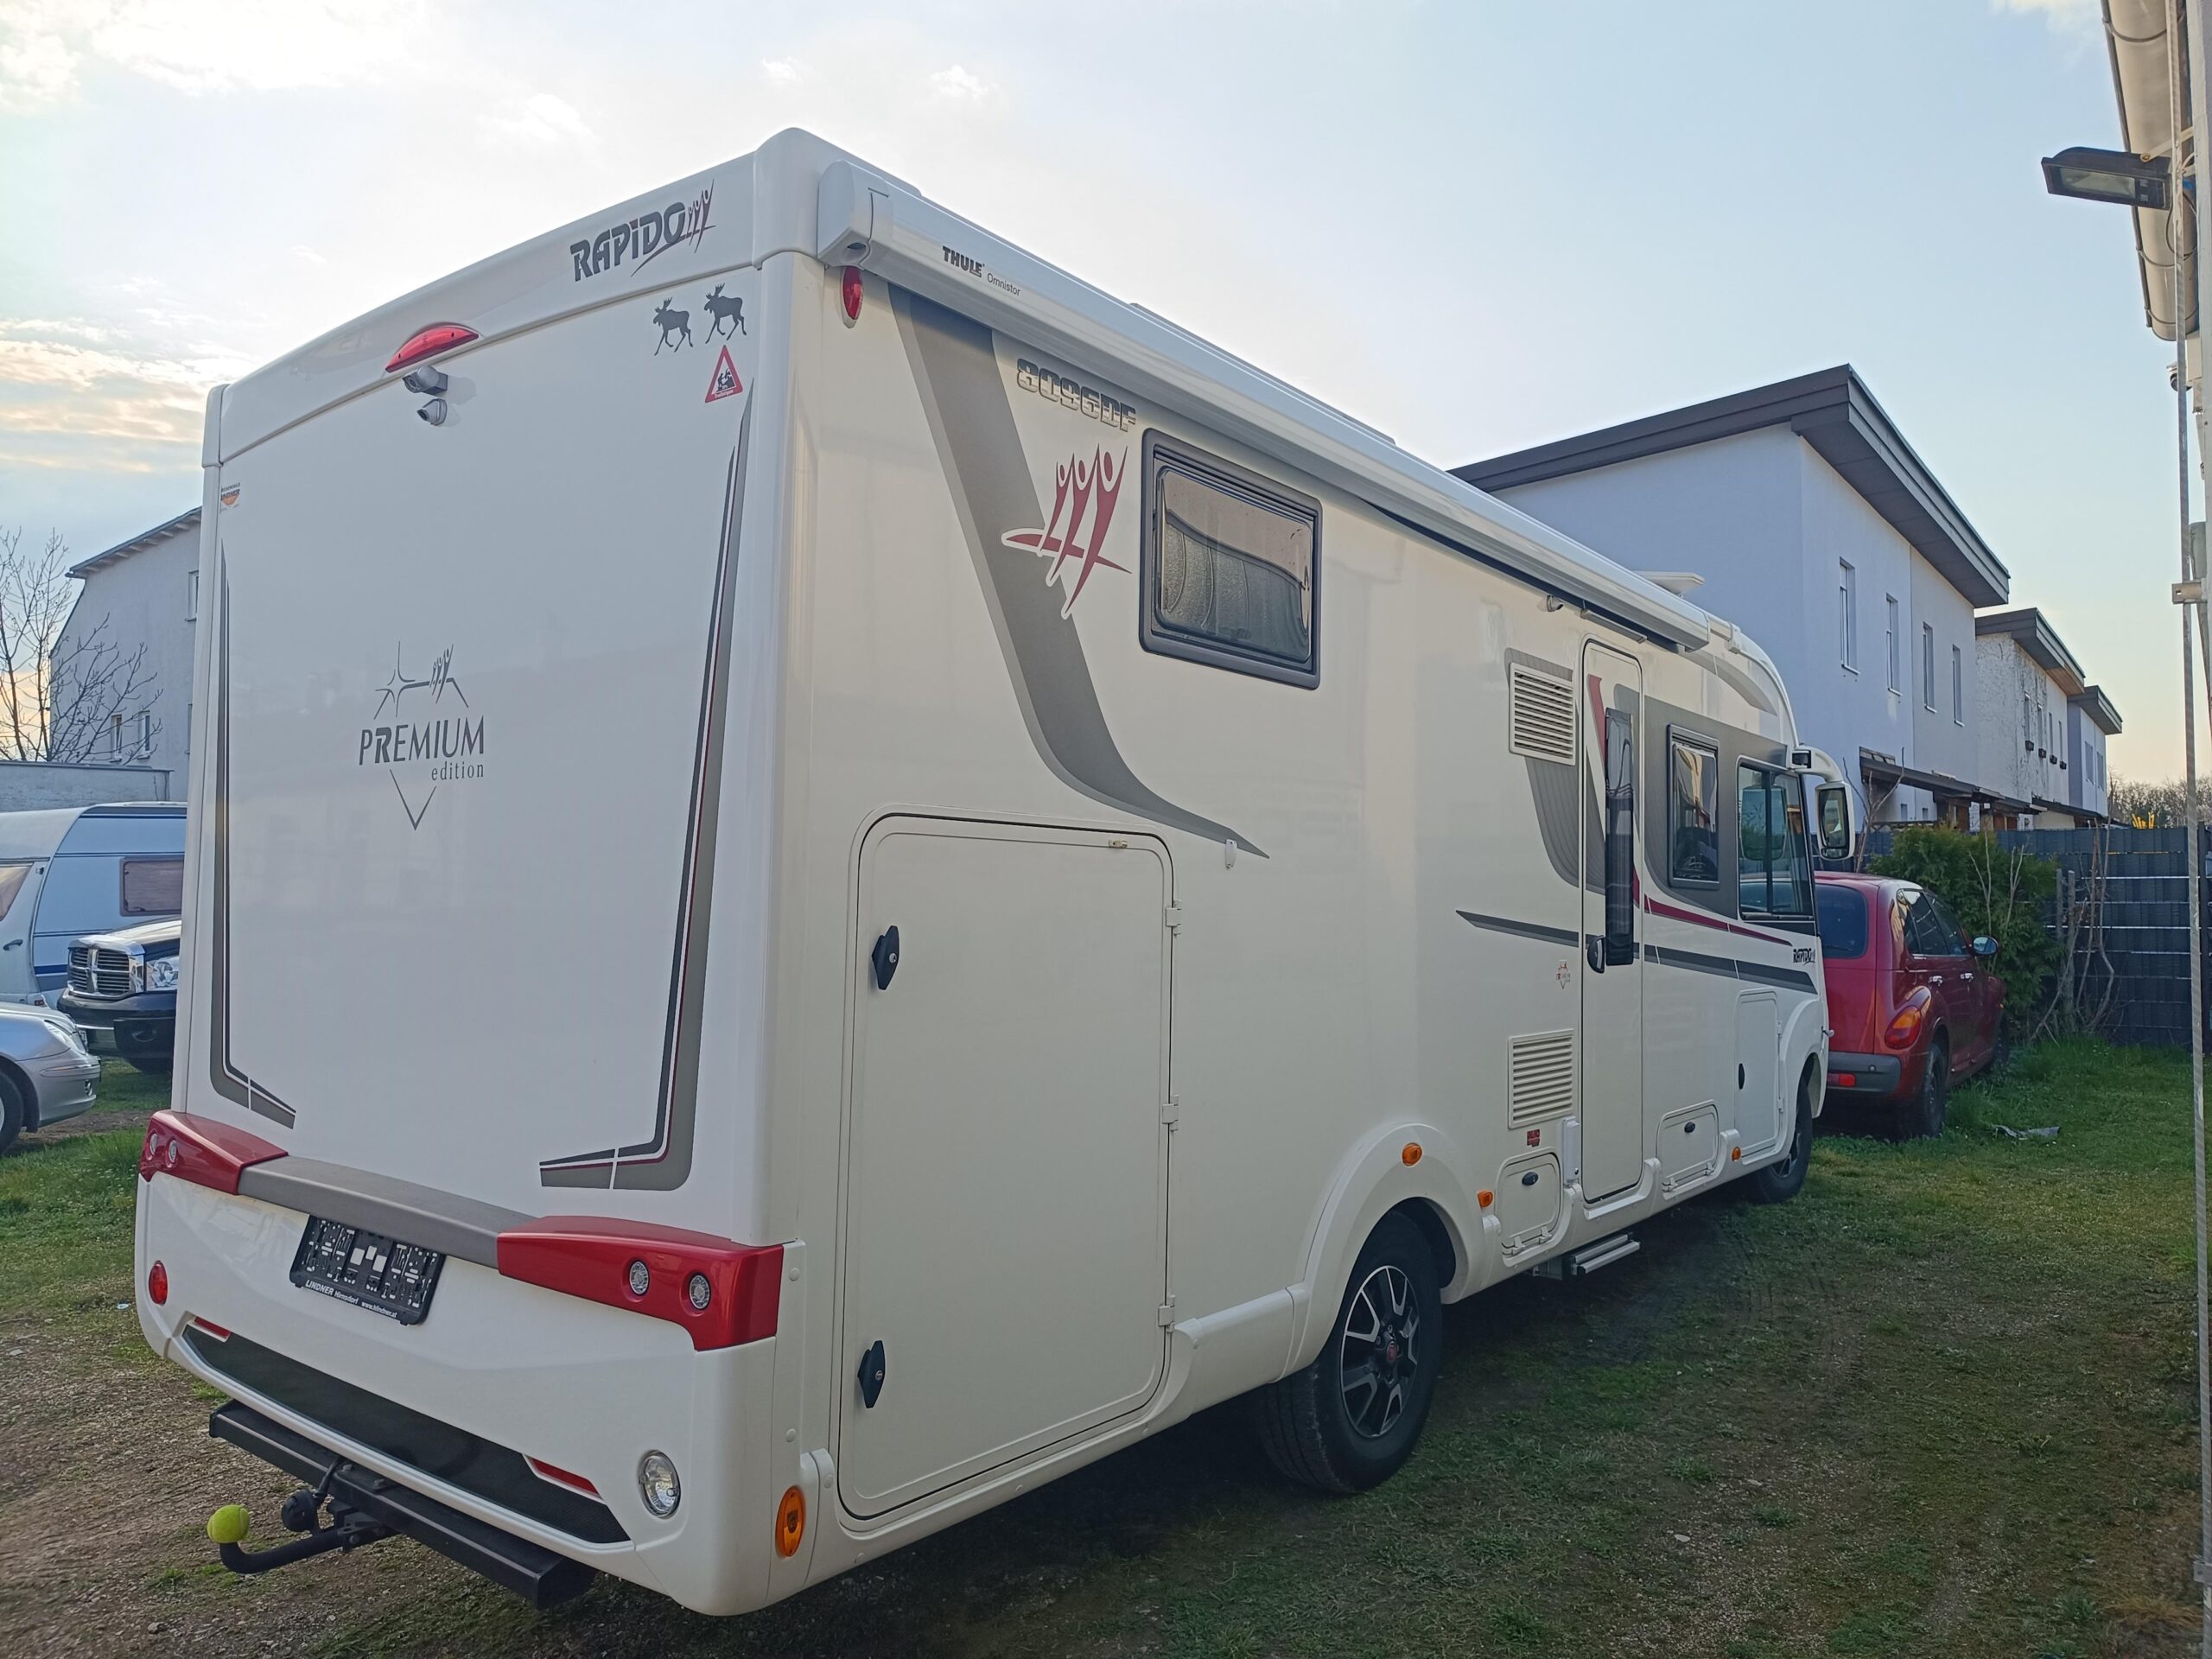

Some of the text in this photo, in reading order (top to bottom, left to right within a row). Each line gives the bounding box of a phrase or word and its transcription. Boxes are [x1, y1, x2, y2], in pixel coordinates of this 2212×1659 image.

[943, 245, 1021, 296] THULE Omnistor
[1016, 358, 1136, 433] 8096DF
[359, 715, 485, 766] PREMIUM
[431, 761, 485, 781] edition
[305, 1279, 334, 1295] LINDNER
